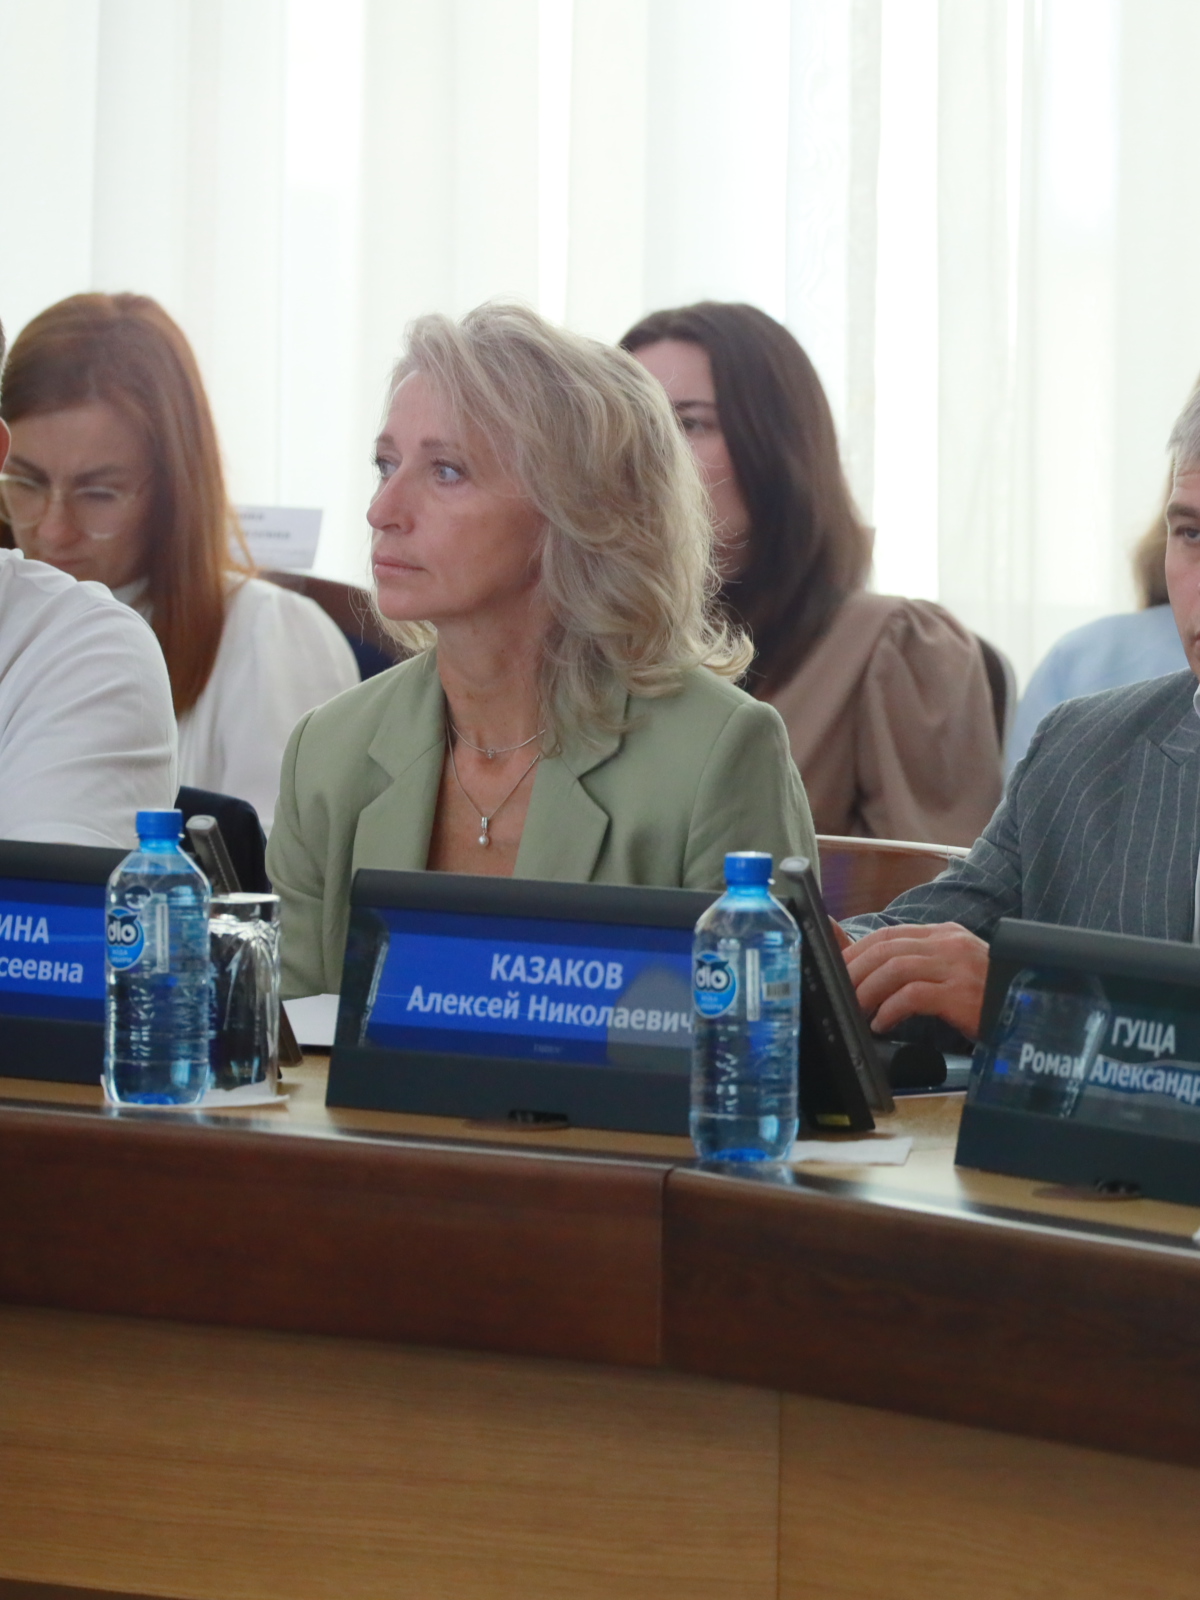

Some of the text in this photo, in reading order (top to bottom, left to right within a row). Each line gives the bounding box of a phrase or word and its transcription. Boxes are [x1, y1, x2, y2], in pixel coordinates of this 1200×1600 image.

[0, 914, 49, 944] ИНА
[0, 956, 84, 984] сеевна
[490, 953, 624, 990] КАЗАКОВ
[406, 985, 694, 1034] Алексей Николаевич
[1111, 1015, 1177, 1058] ГУЩА
